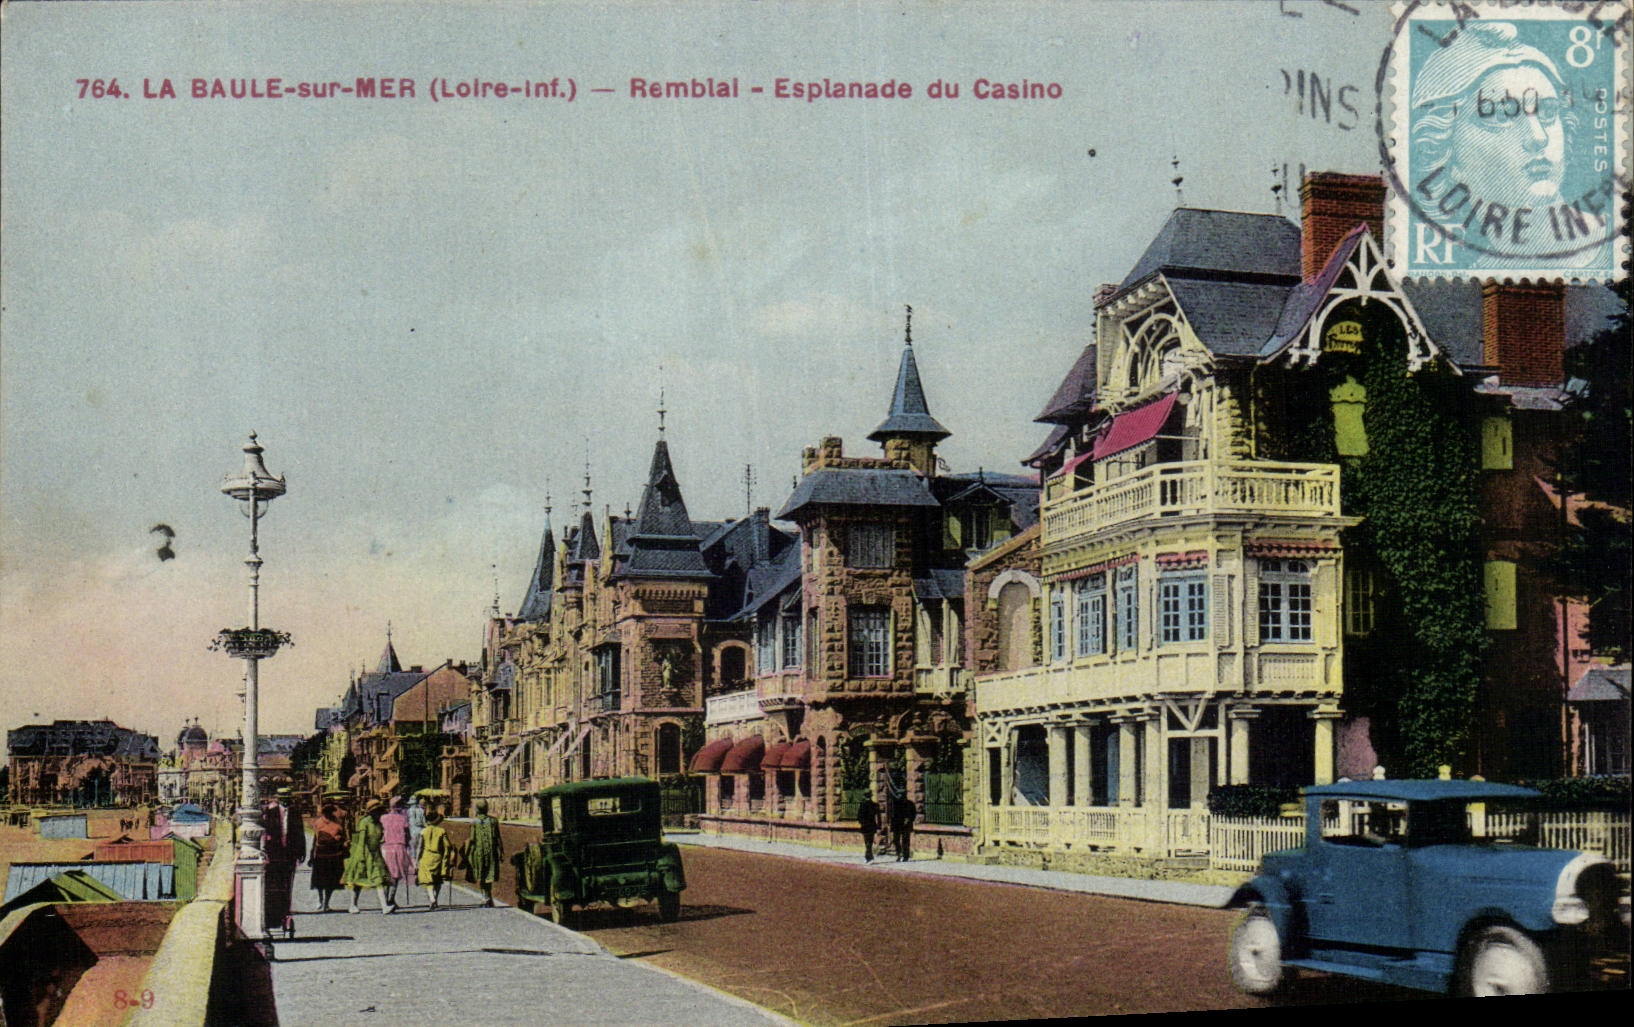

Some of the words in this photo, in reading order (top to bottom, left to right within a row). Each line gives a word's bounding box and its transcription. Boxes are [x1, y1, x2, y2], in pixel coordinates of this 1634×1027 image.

[1594, 87, 1608, 173] POSTES
[1412, 222, 1468, 265] RF
[1416, 165, 1532, 245] LOIRE
